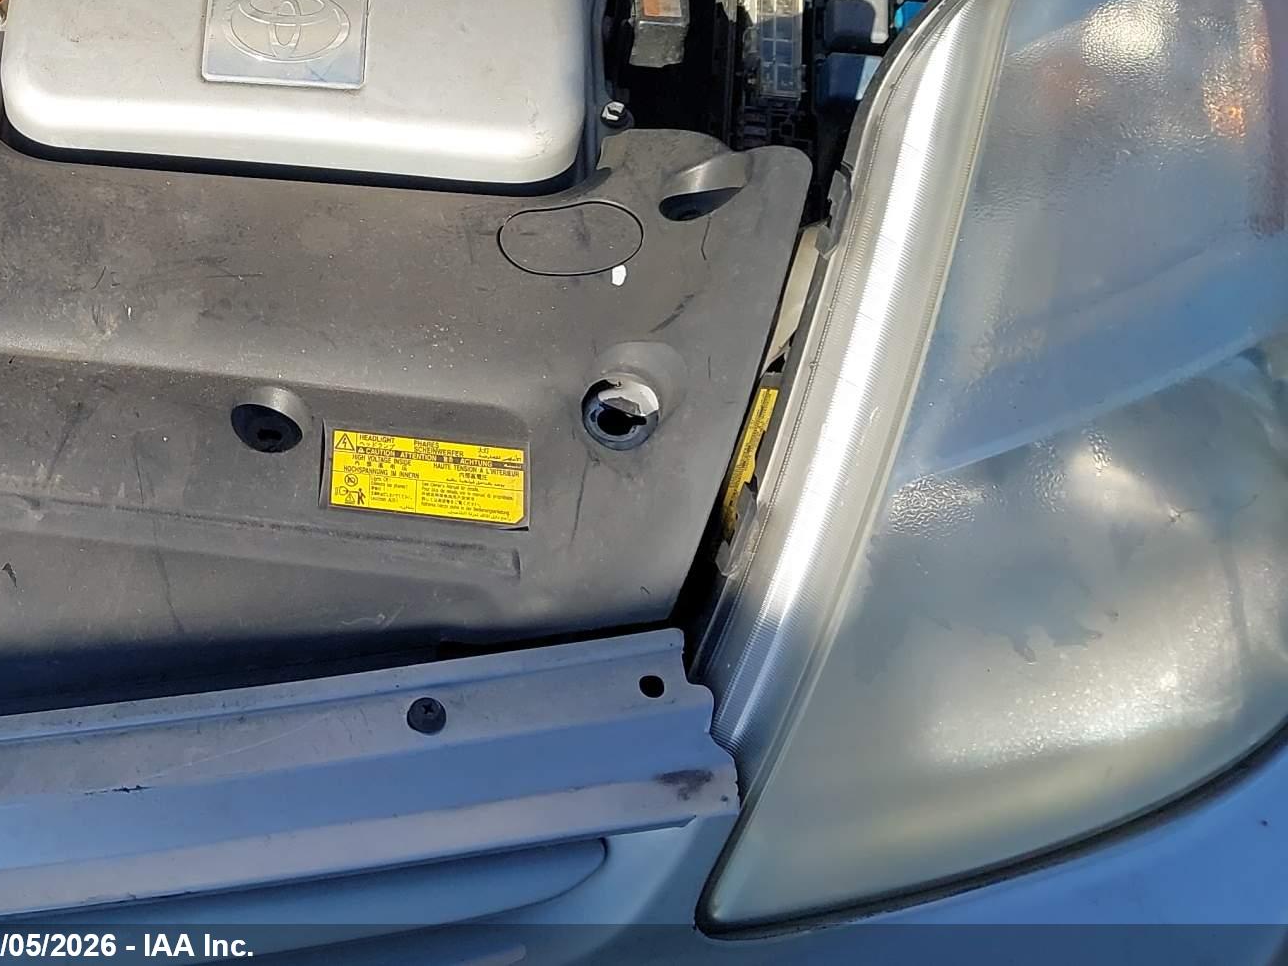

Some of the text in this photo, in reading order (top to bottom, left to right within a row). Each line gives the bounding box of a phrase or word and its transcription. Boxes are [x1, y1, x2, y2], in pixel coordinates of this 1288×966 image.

[359, 434, 395, 444] HEADLIGHT
[366, 447, 396, 457] CAUTION
[400, 451, 437, 461] ATTENTION
[460, 458, 493, 468] ACHTUNG
[367, 455, 392, 464] VOLTAGE
[453, 464, 477, 473] TENSION
